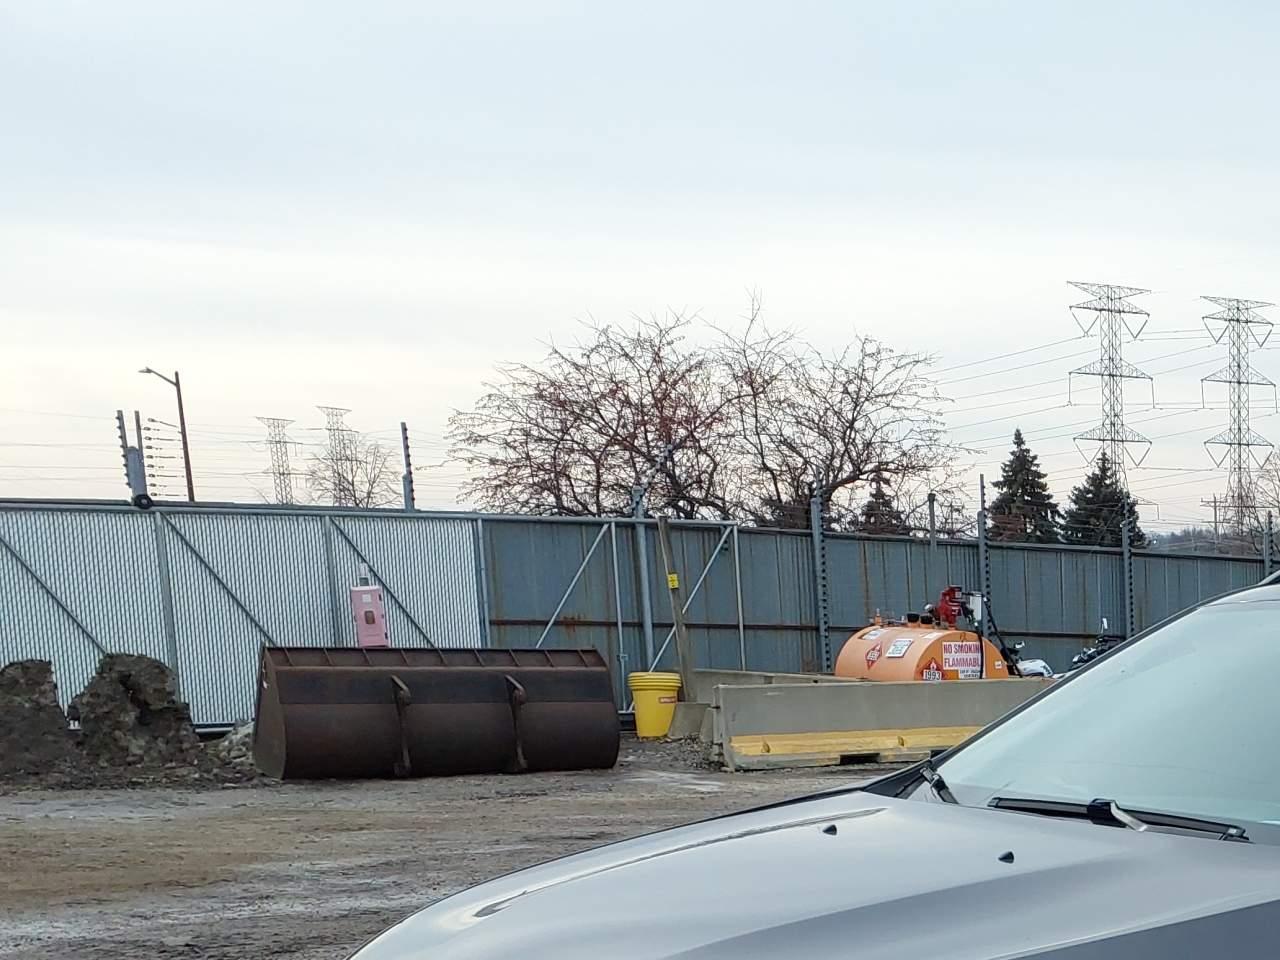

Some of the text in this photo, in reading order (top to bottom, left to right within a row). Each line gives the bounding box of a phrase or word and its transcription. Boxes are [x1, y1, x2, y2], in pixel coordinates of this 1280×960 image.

[943, 643, 981, 654] NO SMOKIN
[944, 657, 981, 668] FLAMMABL
[924, 670, 942, 681] 1993
